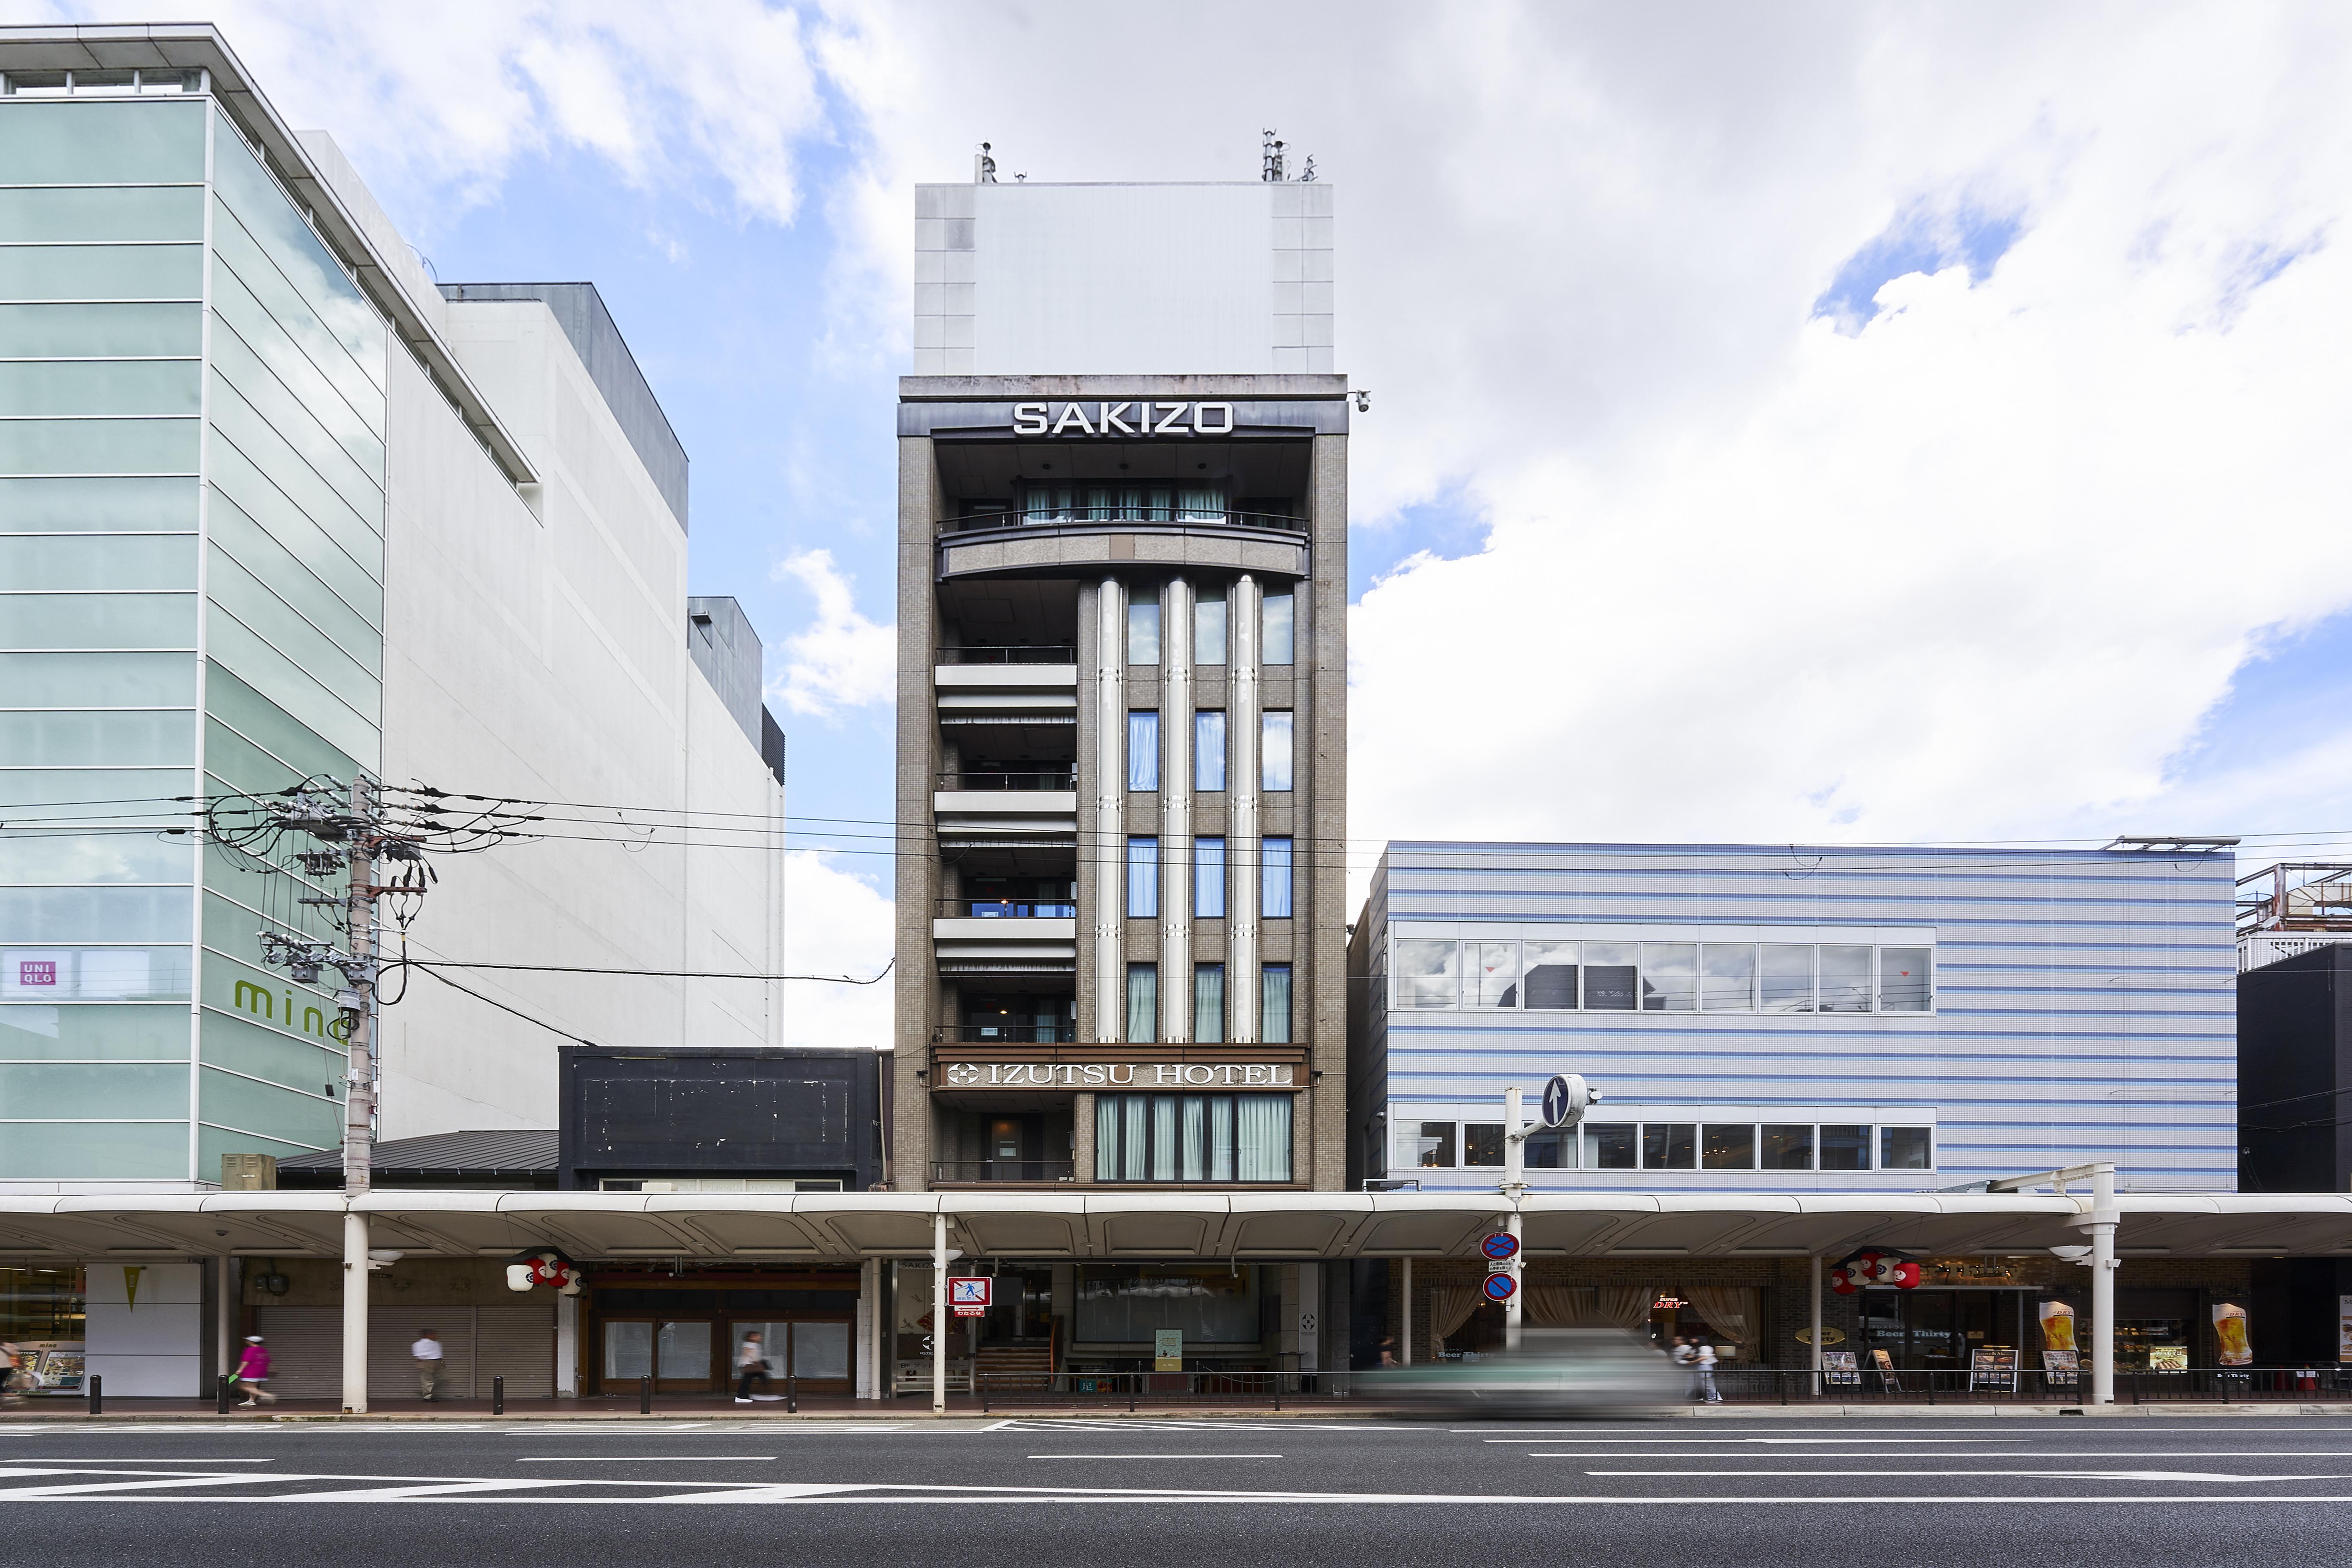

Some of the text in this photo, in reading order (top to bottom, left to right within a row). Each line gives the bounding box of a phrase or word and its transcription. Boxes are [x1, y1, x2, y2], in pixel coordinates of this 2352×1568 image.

[1014, 402, 1233, 434] SAKIZO
[24, 964, 49, 973] UNI
[24, 974, 51, 984] QLO
[987, 1064, 1292, 1085] IZUTSU HOTEL
